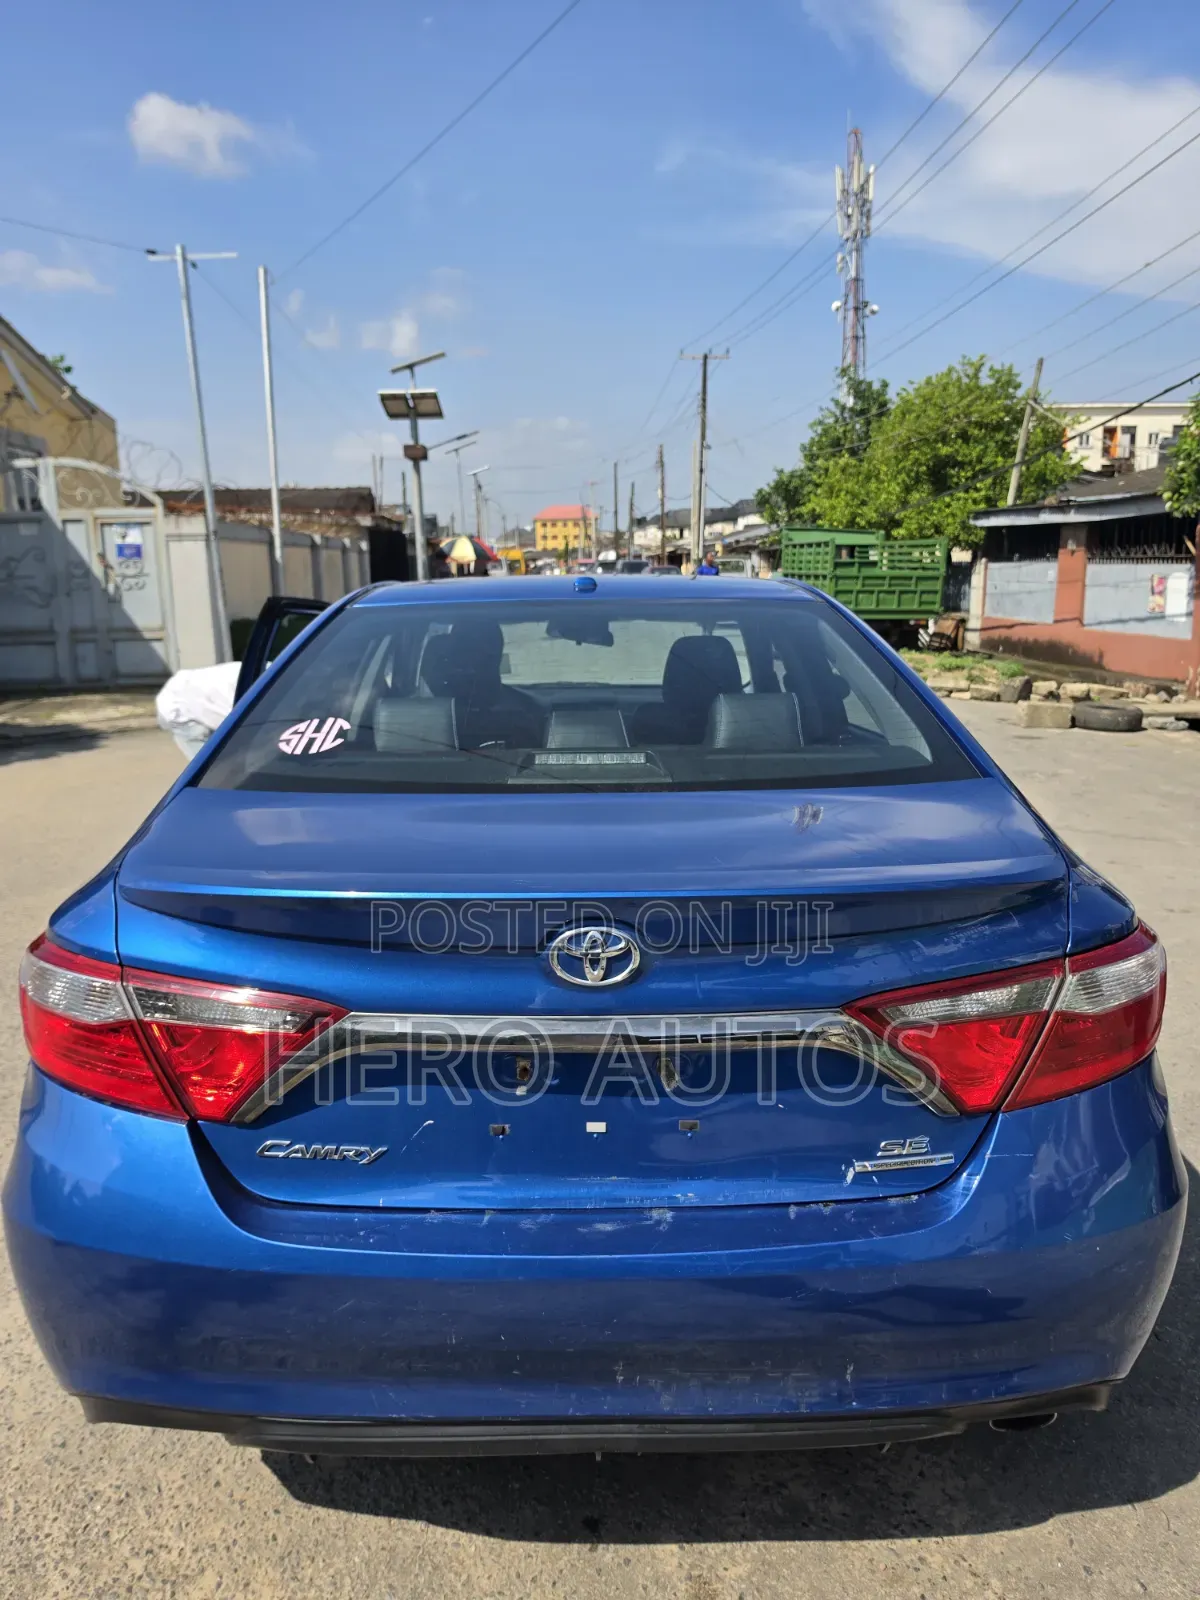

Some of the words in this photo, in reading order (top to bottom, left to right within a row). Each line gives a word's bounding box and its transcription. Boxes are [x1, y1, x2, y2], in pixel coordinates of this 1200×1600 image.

[278, 716, 352, 755] SHC
[256, 1139, 388, 1165] CAMRY
[876, 1138, 930, 1157] SE
